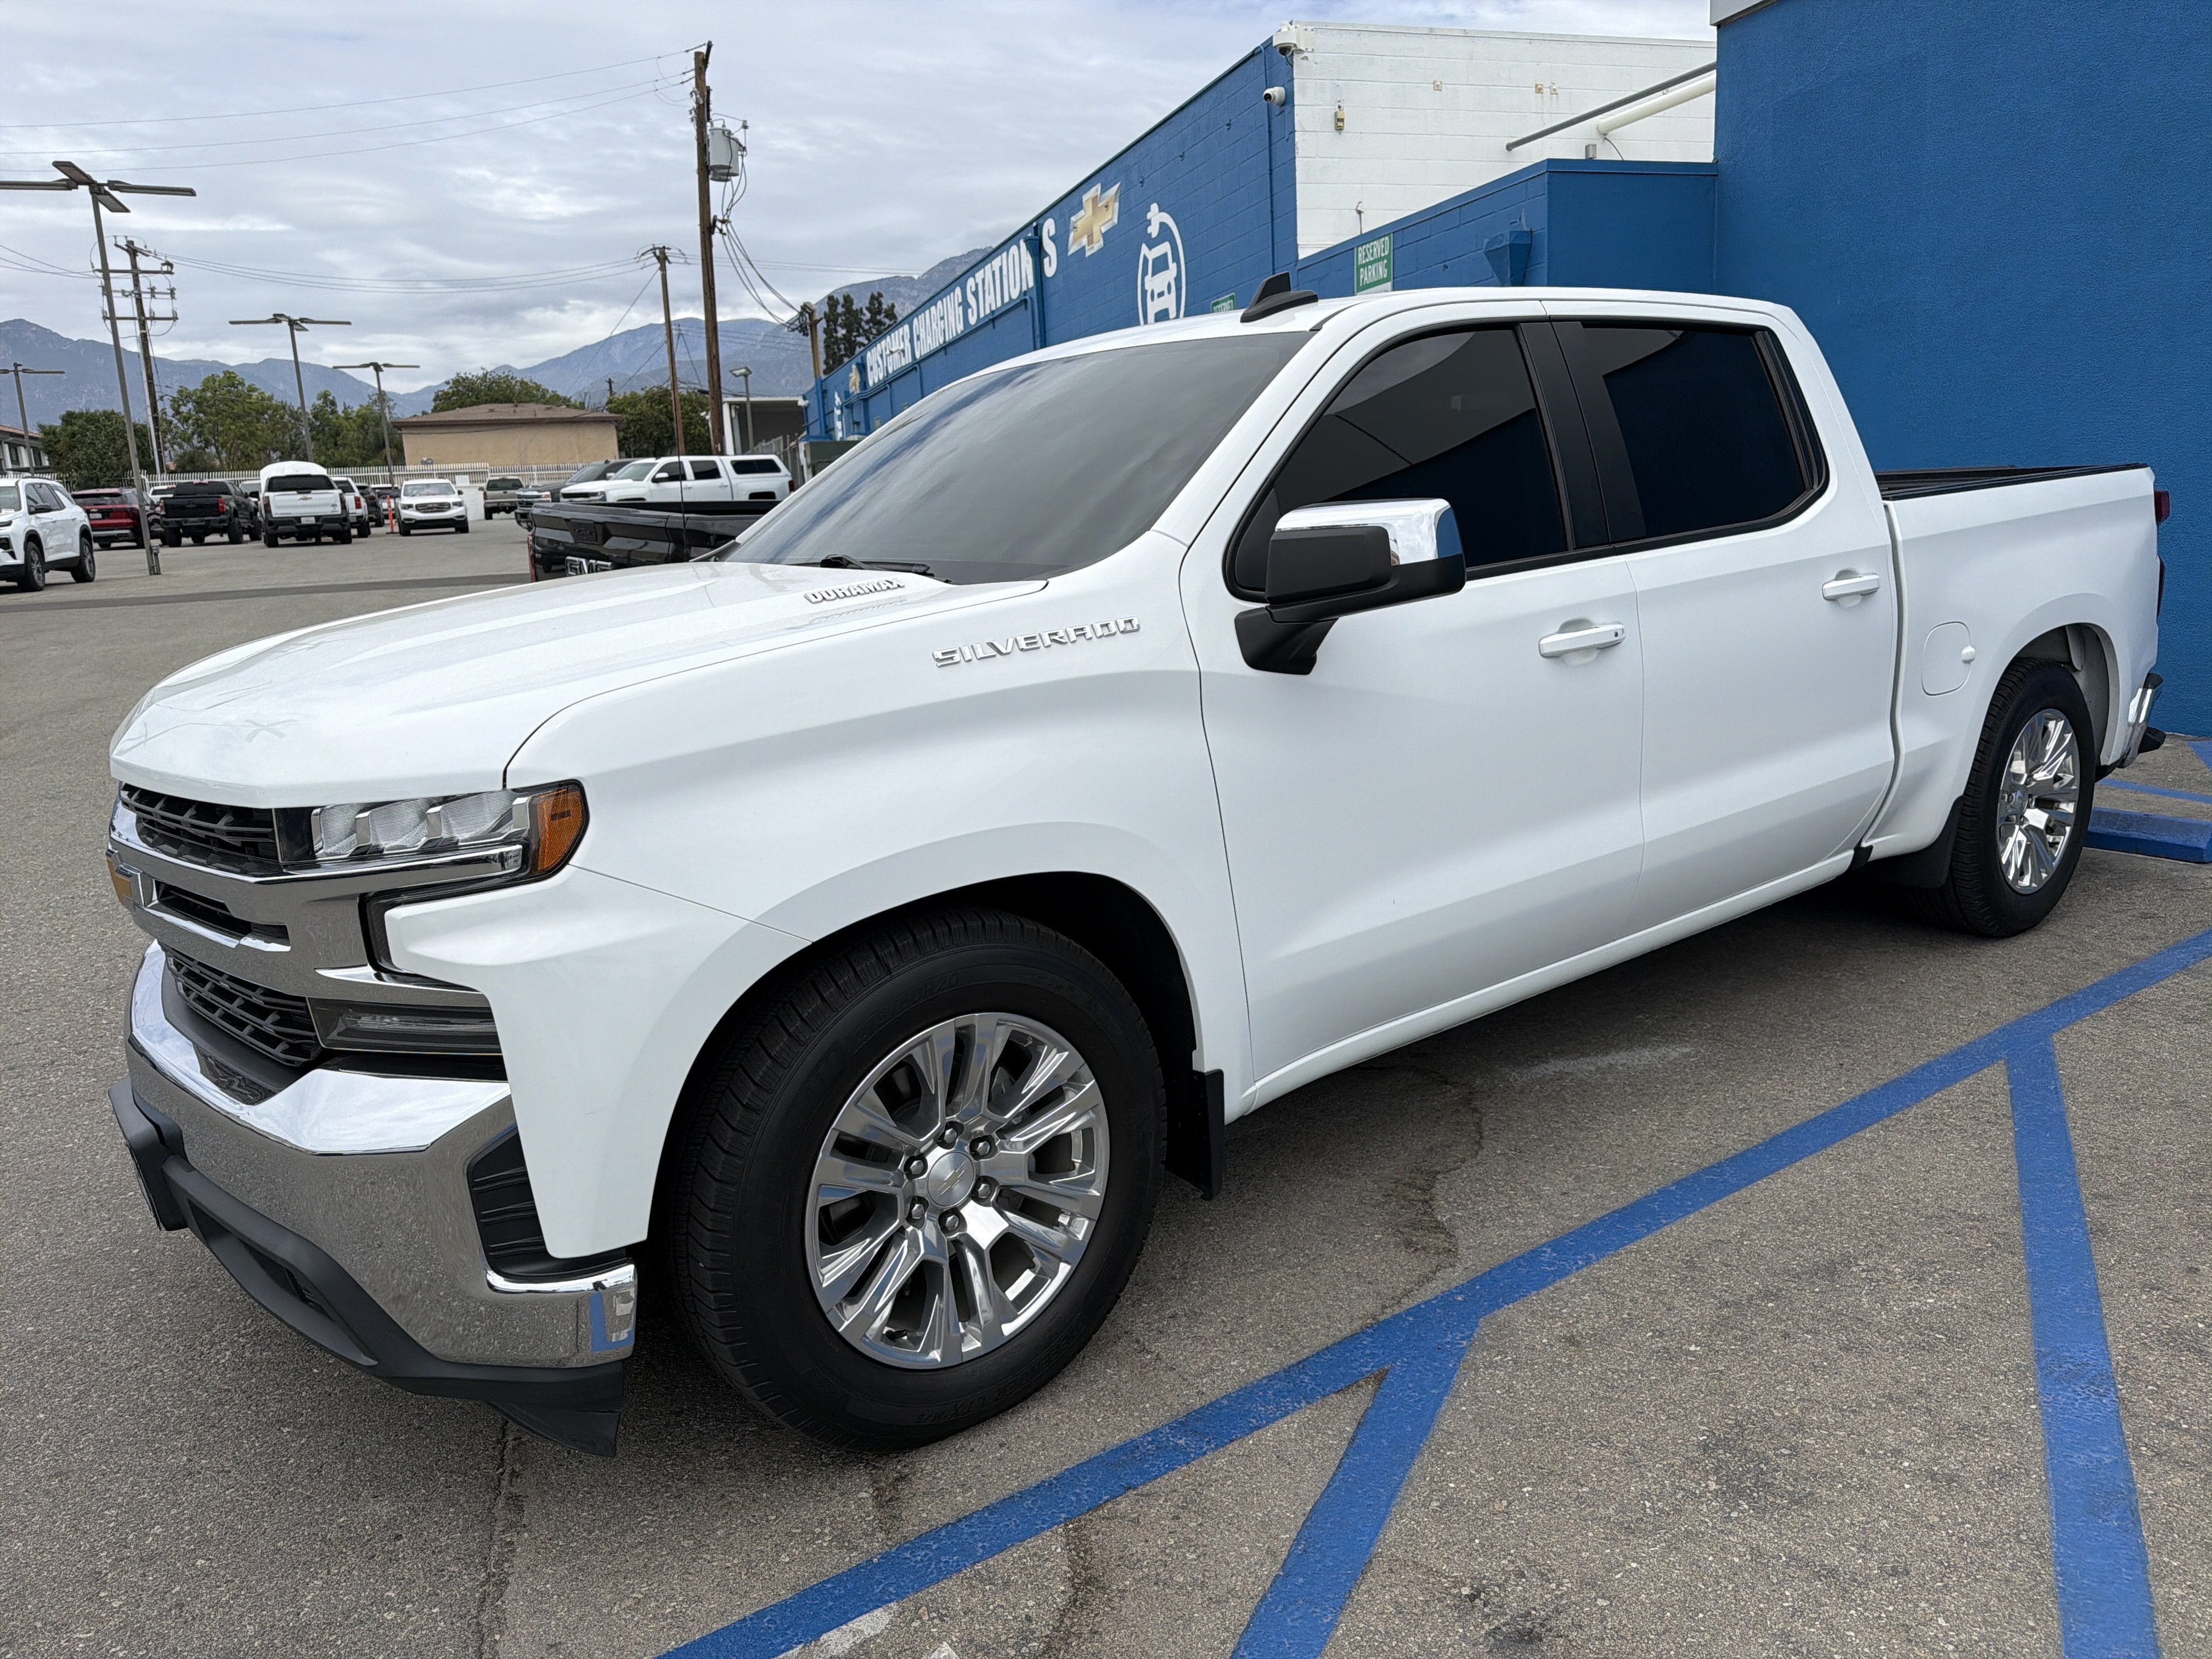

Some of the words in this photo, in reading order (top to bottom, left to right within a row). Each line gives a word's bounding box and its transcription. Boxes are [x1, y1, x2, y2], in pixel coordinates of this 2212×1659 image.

[1358, 236, 1390, 265] RESERVED
[1359, 259, 1388, 286] PARKING
[867, 324, 912, 387] CUSTOMER
[912, 286, 964, 360] CHARGING
[803, 578, 905, 603] DURAMAX
[933, 616, 1141, 668] SILVERADO
